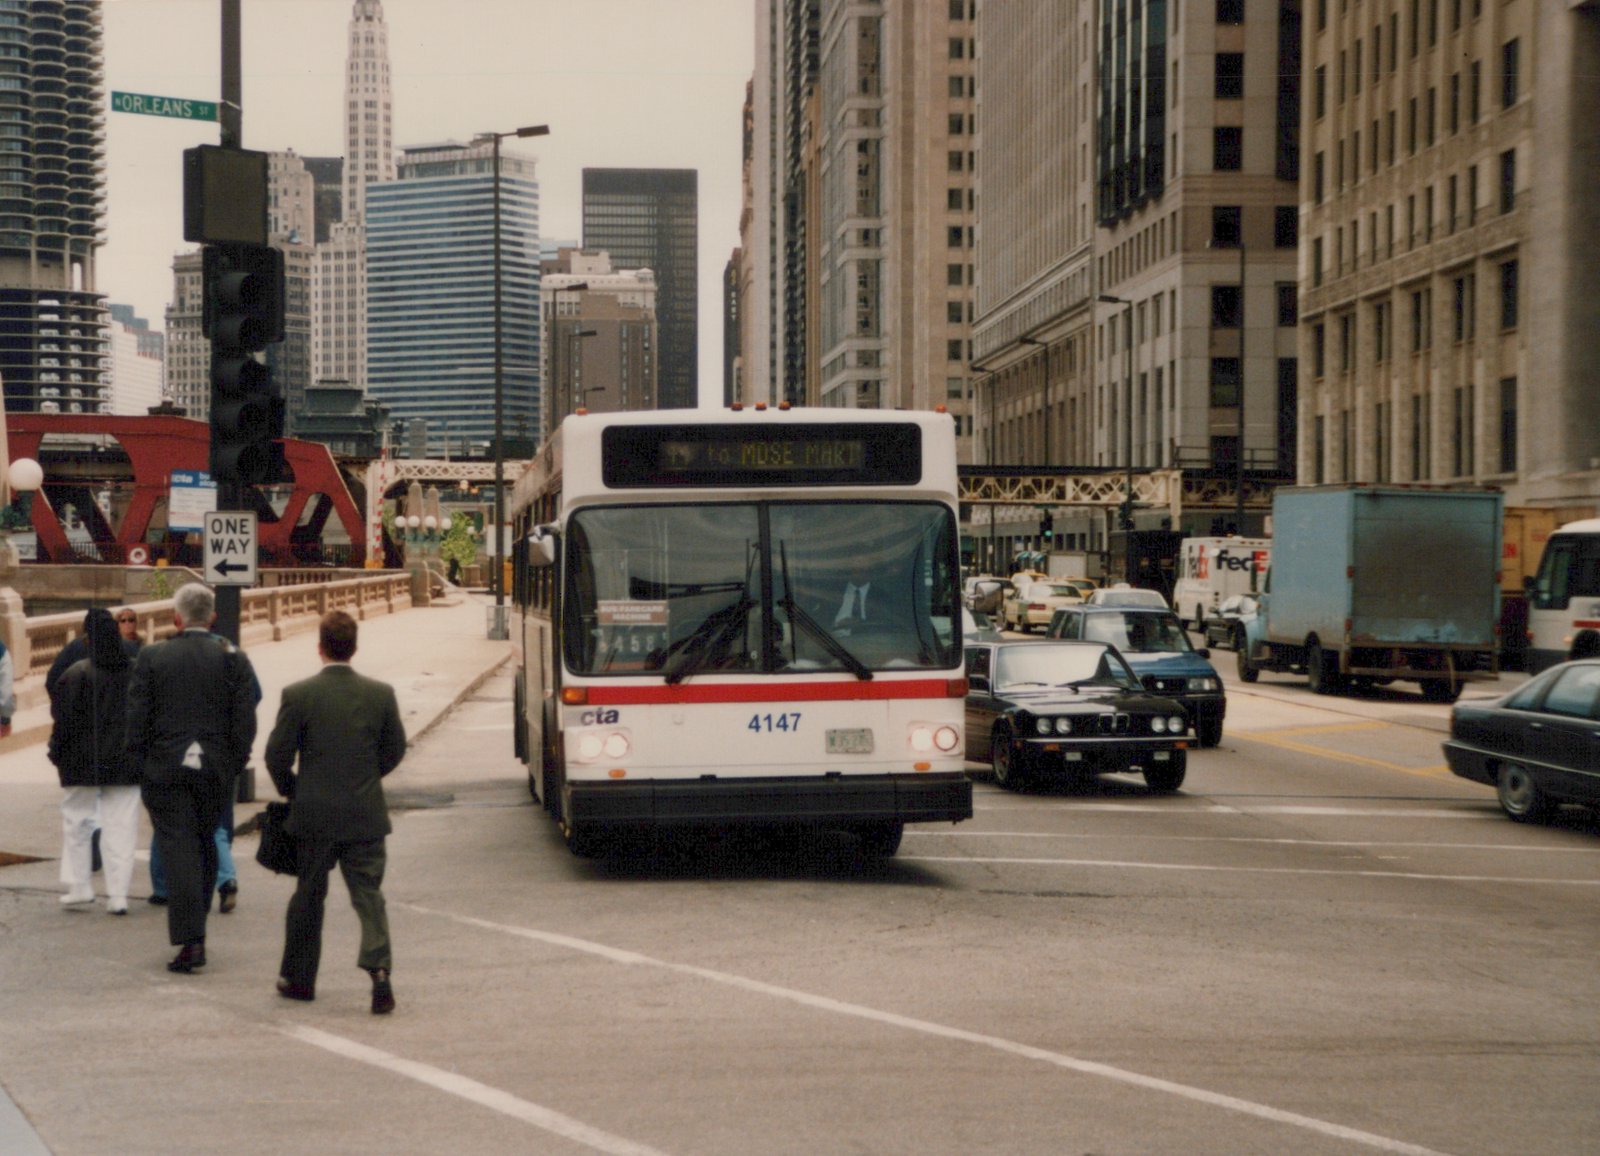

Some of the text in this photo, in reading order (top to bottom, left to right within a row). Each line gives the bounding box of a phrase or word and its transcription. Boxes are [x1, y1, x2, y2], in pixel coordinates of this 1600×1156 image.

[122, 95, 193, 117] ORLEANS
[199, 106, 209, 116] ST
[211, 518, 250, 535] ONE
[210, 538, 250, 554] WAY
[580, 706, 619, 726] cta
[748, 713, 802, 732] 4147
